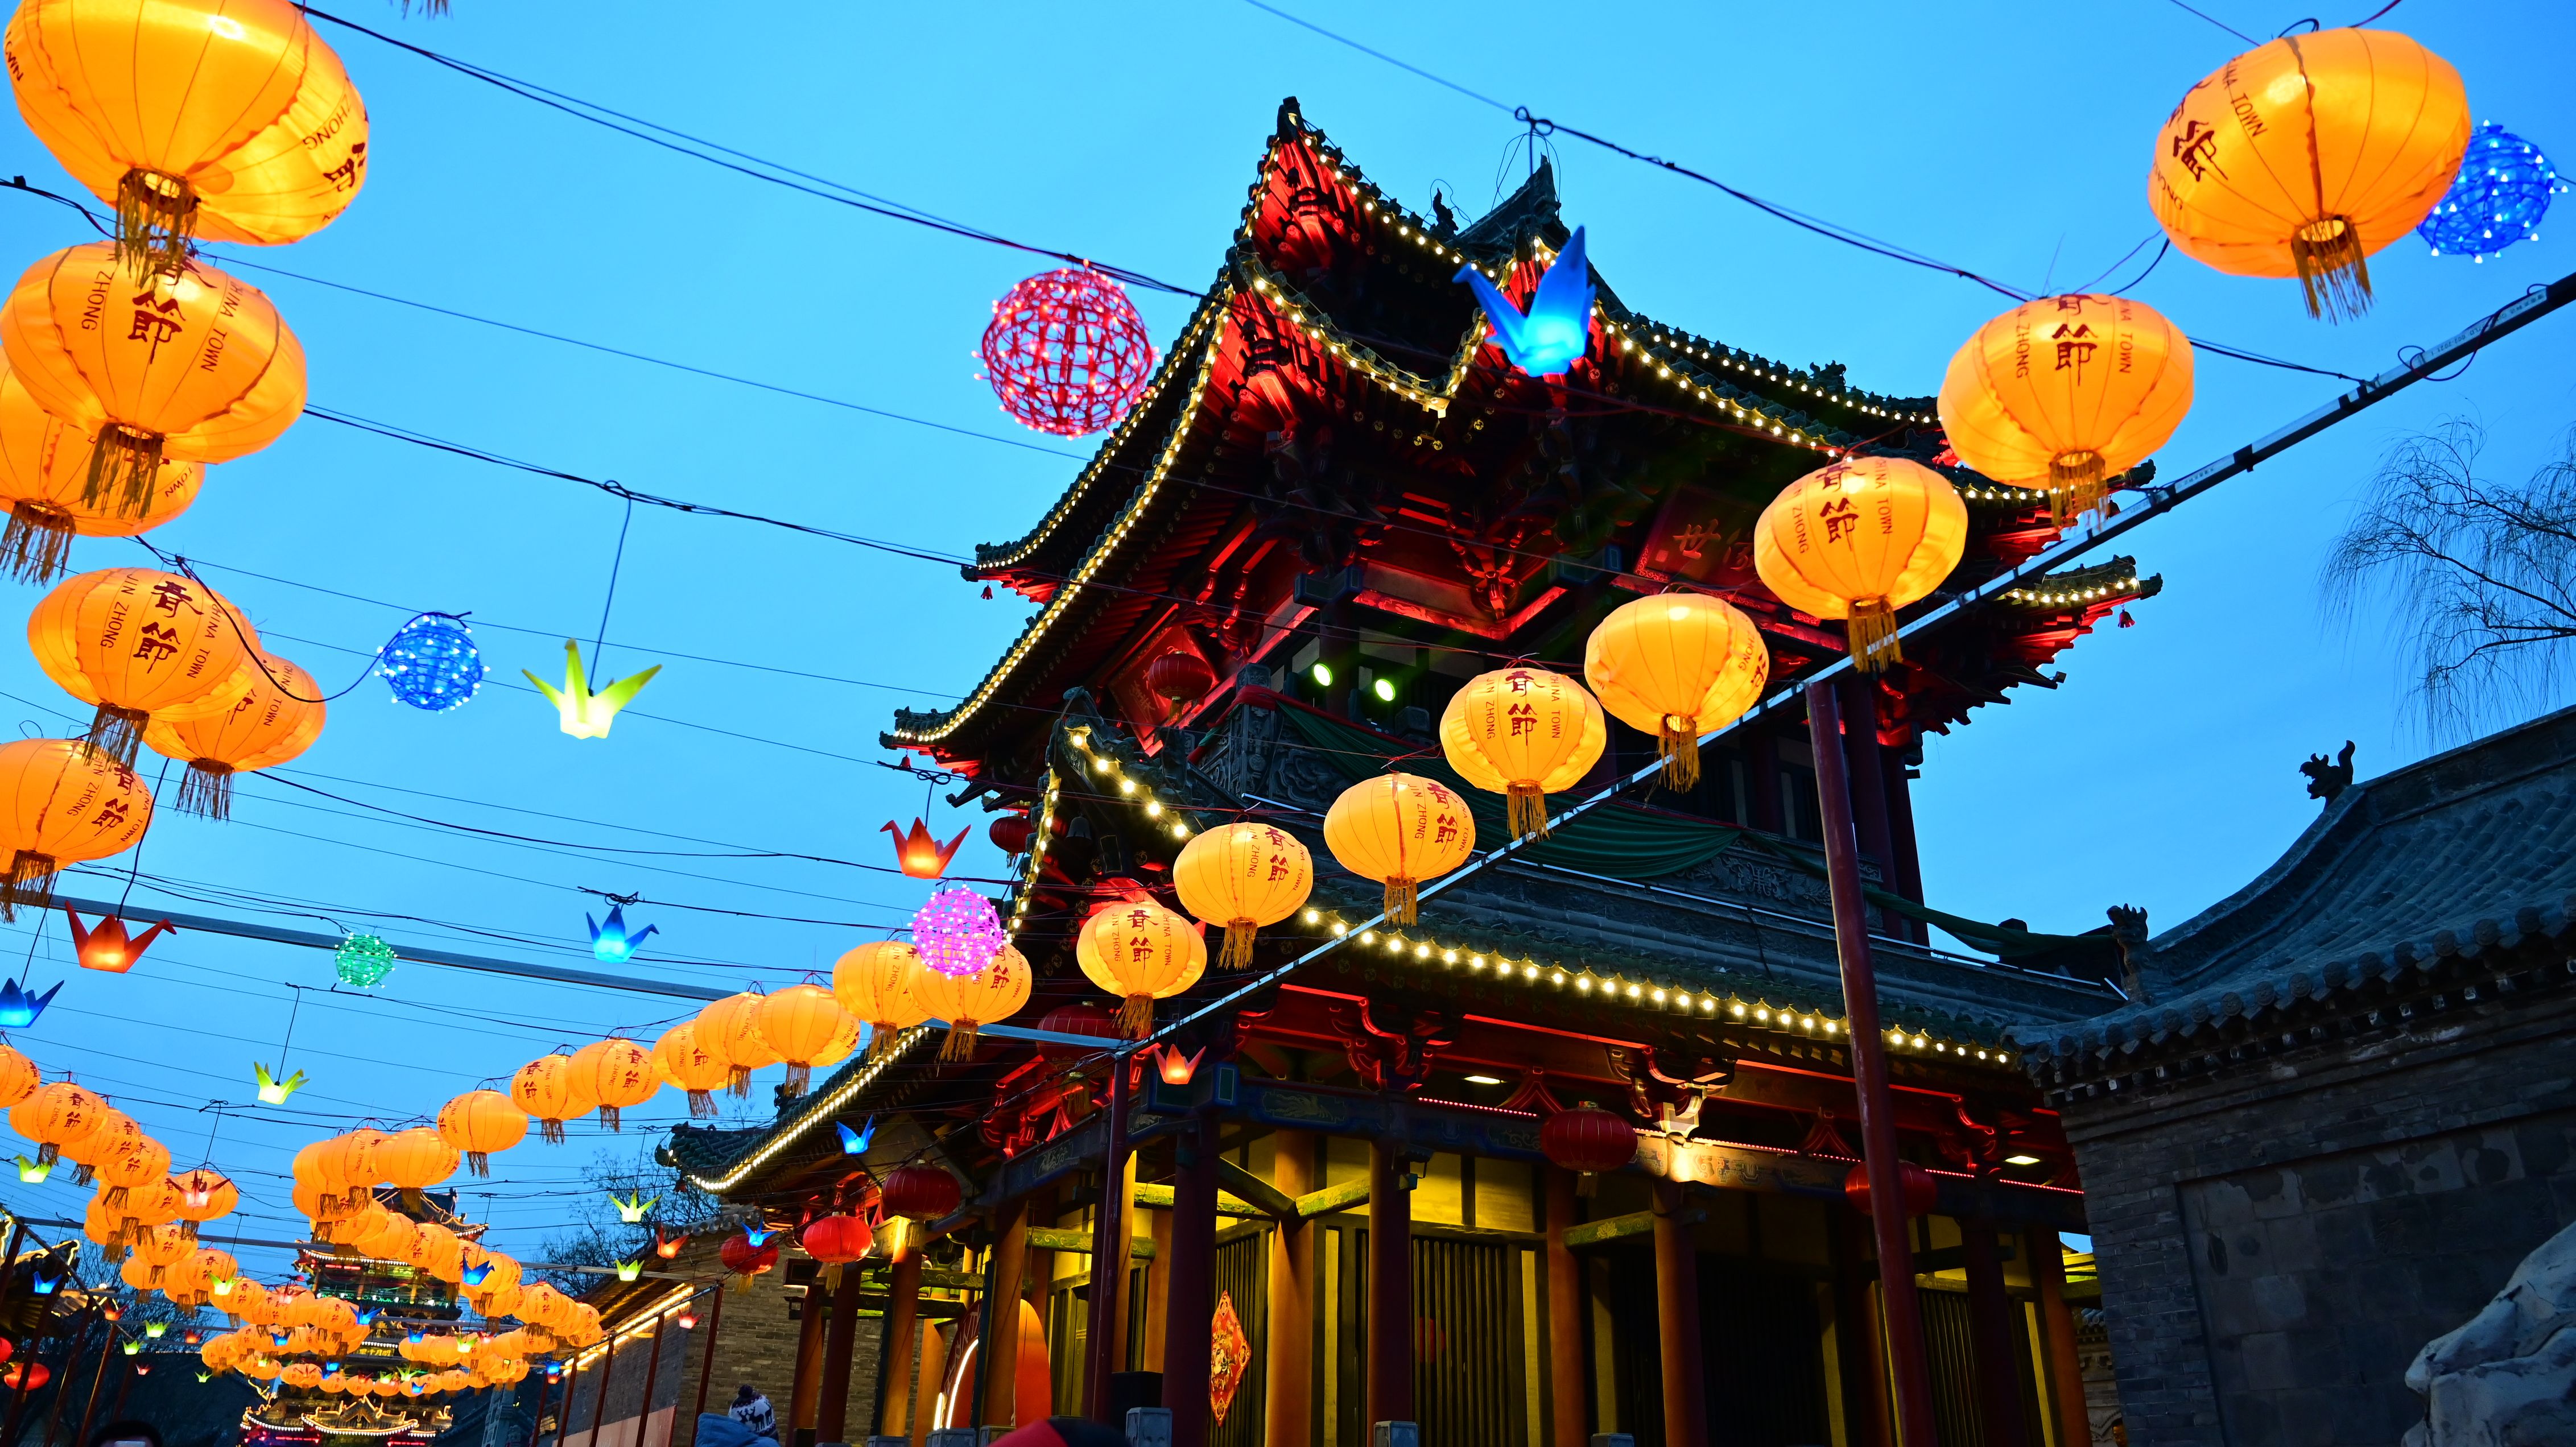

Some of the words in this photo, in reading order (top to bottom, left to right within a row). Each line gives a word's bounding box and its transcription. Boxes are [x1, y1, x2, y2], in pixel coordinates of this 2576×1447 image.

[303, 94, 352, 150] ZHONG
[81, 271, 115, 330] ZHONG
[201, 328, 228, 372] TOWN
[2016, 323, 2030, 379] ZHONG
[2119, 332, 2133, 374] TOWN
[1793, 505, 1809, 554] ZHONG
[1877, 498, 1893, 535] TOWN
[121, 573, 139, 595] JIN
[100, 601, 130, 648] ZHONG
[205, 603, 222, 639] CHINA
[187, 648, 210, 679] TOWN
[1485, 677, 1495, 693] JIN
[1550, 675, 1560, 702] CHINA
[263, 698, 283, 726] TOWN
[1485, 701, 1496, 740] ZHONG
[1551, 710, 1561, 739] TOWN
[67, 782, 100, 816] ZHONG
[1407, 784, 1423, 797] JIN
[120, 818, 143, 842] TOWN
[1247, 826, 1258, 840] JIN
[1414, 803, 1427, 839] ZHONG
[1459, 827, 1469, 851] TOWN
[1247, 844, 1260, 878] ZHONG
[1293, 869, 1304, 891] TOWN
[1112, 932, 1121, 962] ZHONG
[885, 965, 900, 992] ZHONG
[1013, 978, 1023, 998] TOWN
[839, 1019, 854, 1043] ZHONG
[544, 1063, 556, 1080] CHINA
[608, 1064, 620, 1086] ZHONG
[49, 1107, 61, 1127] ZHONG
[450, 1119, 459, 1134] TOWN
